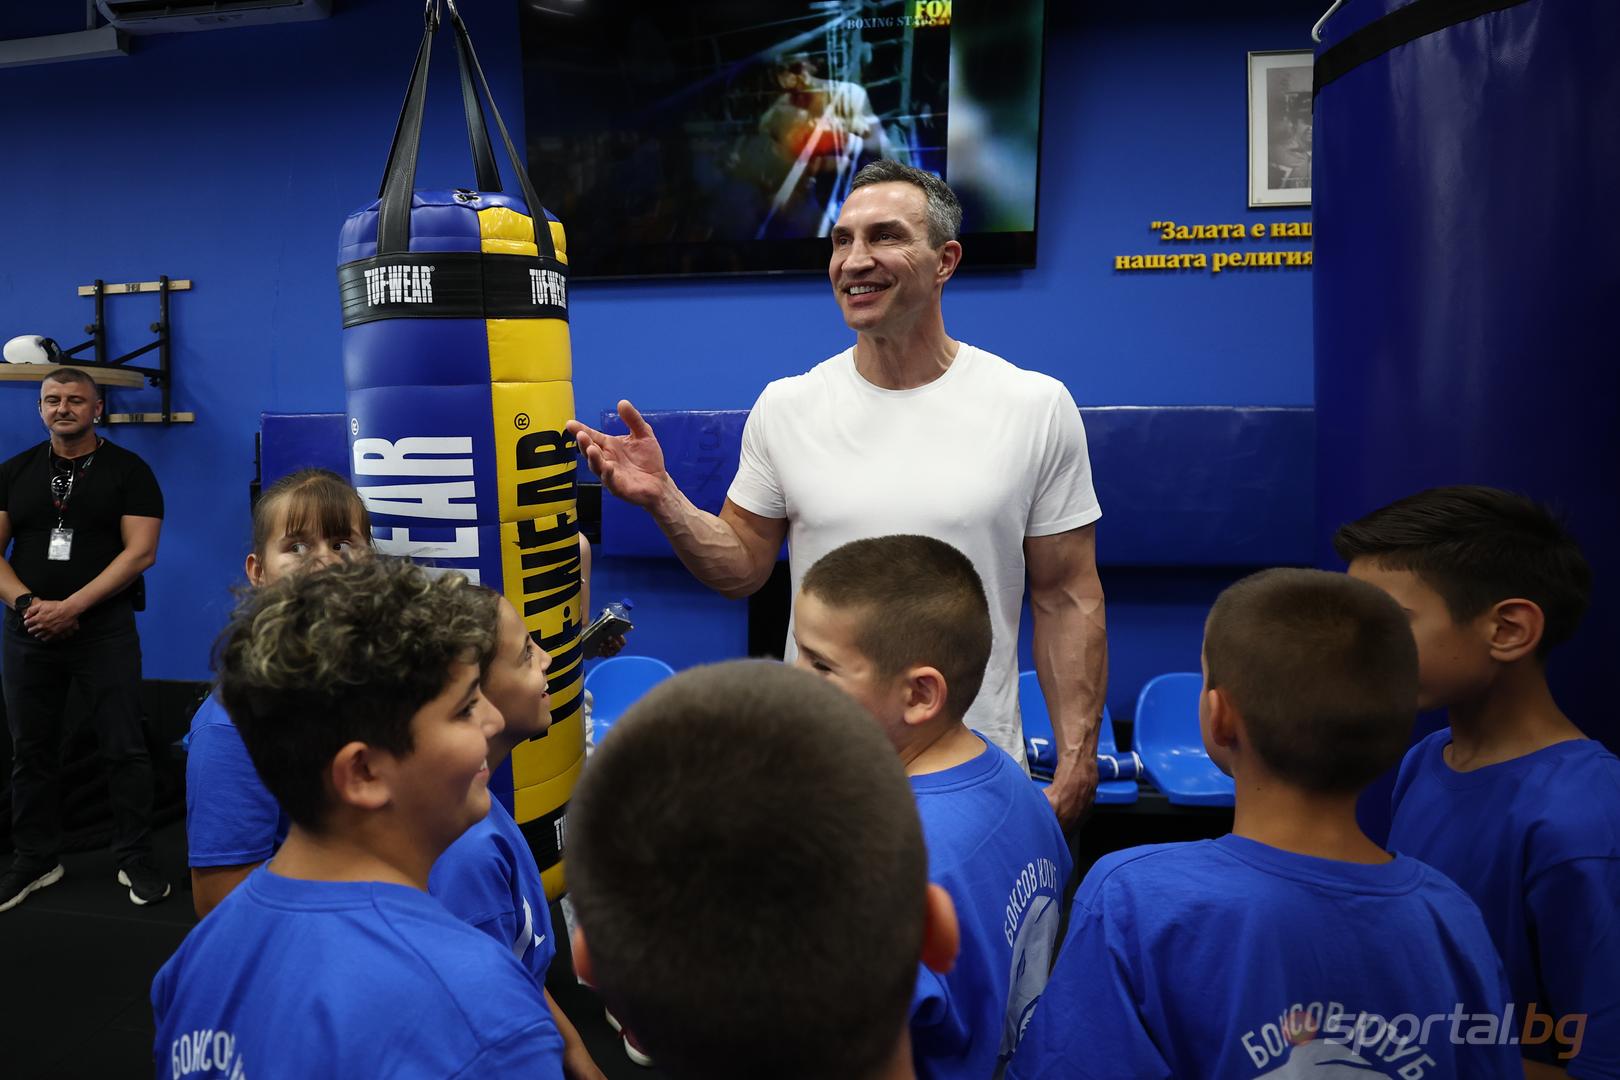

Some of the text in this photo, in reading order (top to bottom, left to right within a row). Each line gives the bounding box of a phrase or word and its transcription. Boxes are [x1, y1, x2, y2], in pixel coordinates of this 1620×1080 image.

[848, 17, 894, 29] BOXING
[1251, 223, 1266, 237] е
[1115, 253, 1207, 269] нашата
[1241, 1001, 1344, 1069] БОКСОВ
